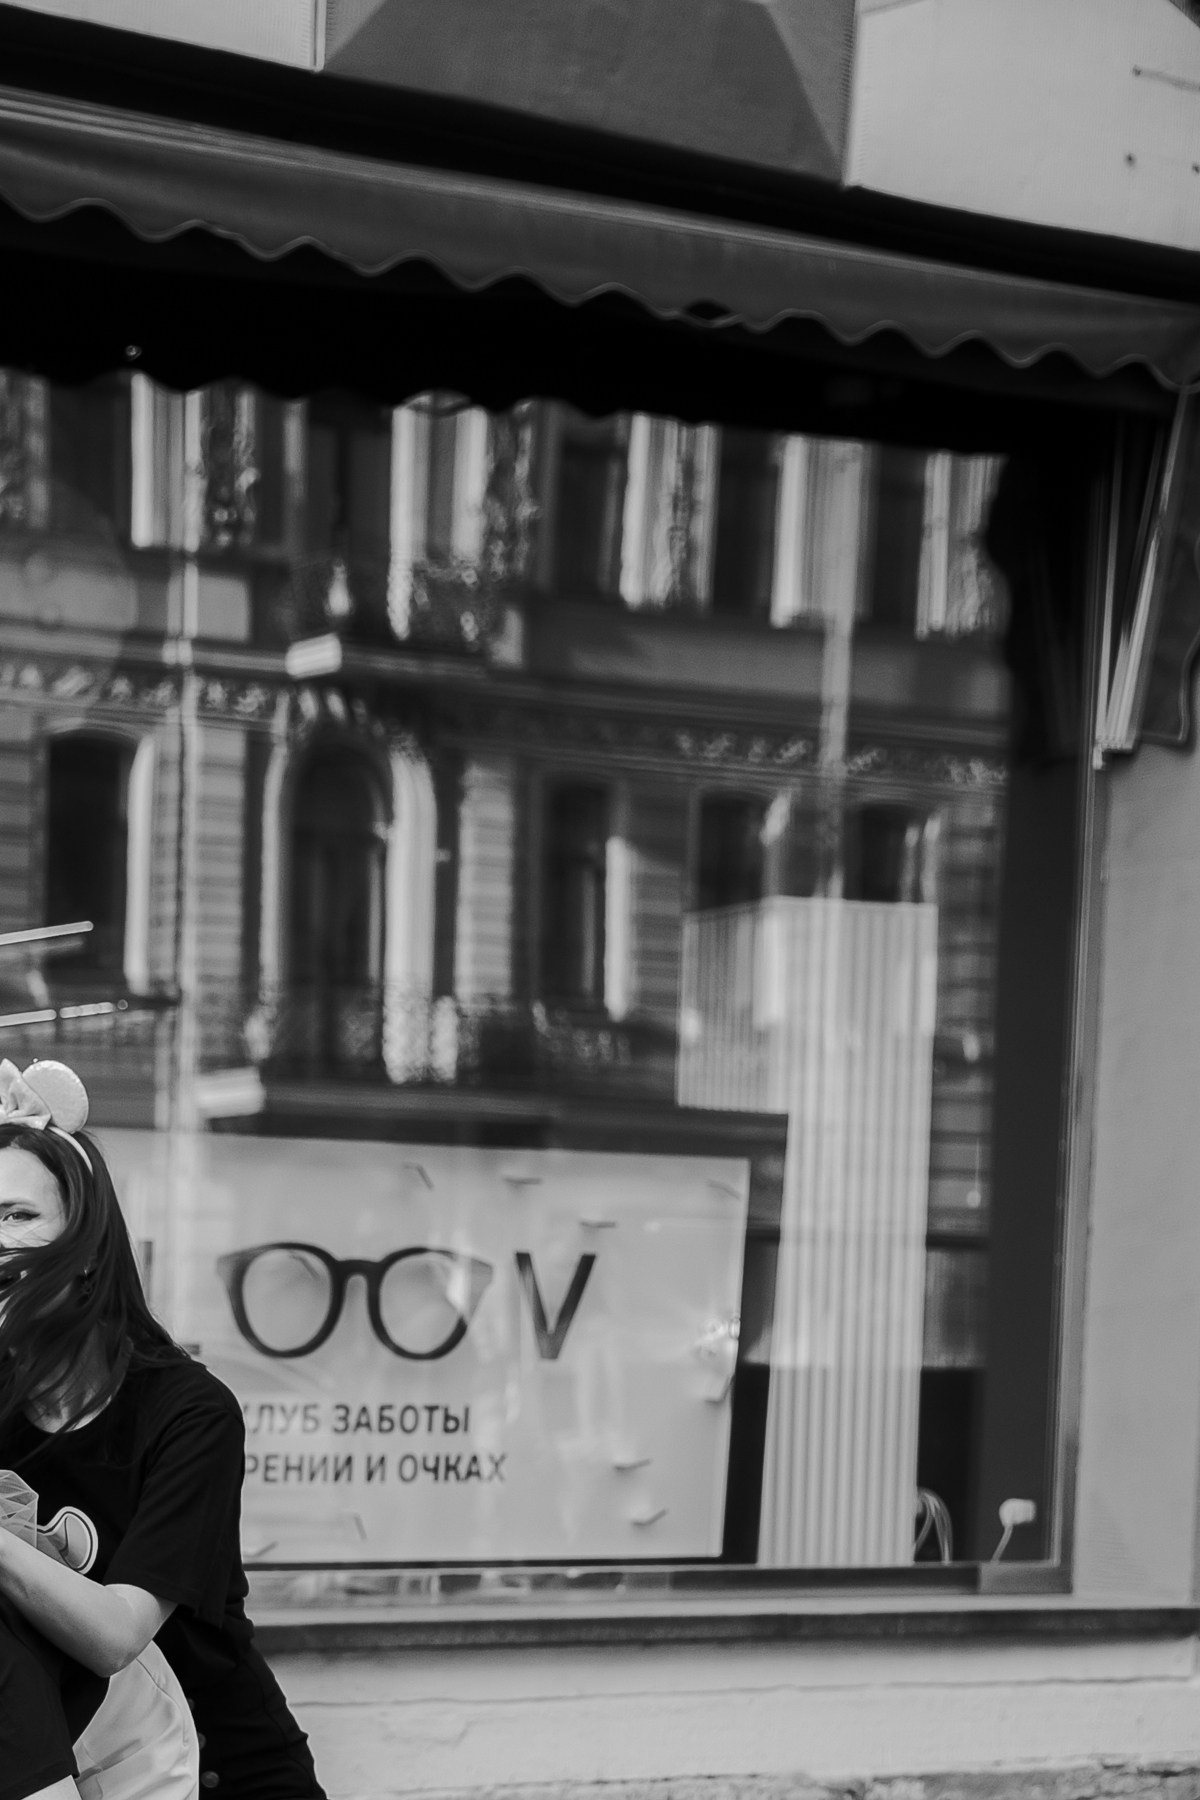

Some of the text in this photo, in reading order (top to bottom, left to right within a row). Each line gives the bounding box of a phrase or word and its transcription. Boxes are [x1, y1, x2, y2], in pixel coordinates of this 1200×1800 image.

[243, 1403, 470, 1434] ЛУБ ЗАБОТЫ
[365, 1454, 387, 1483] И
[398, 1453, 506, 1483] ОЧКАХ
